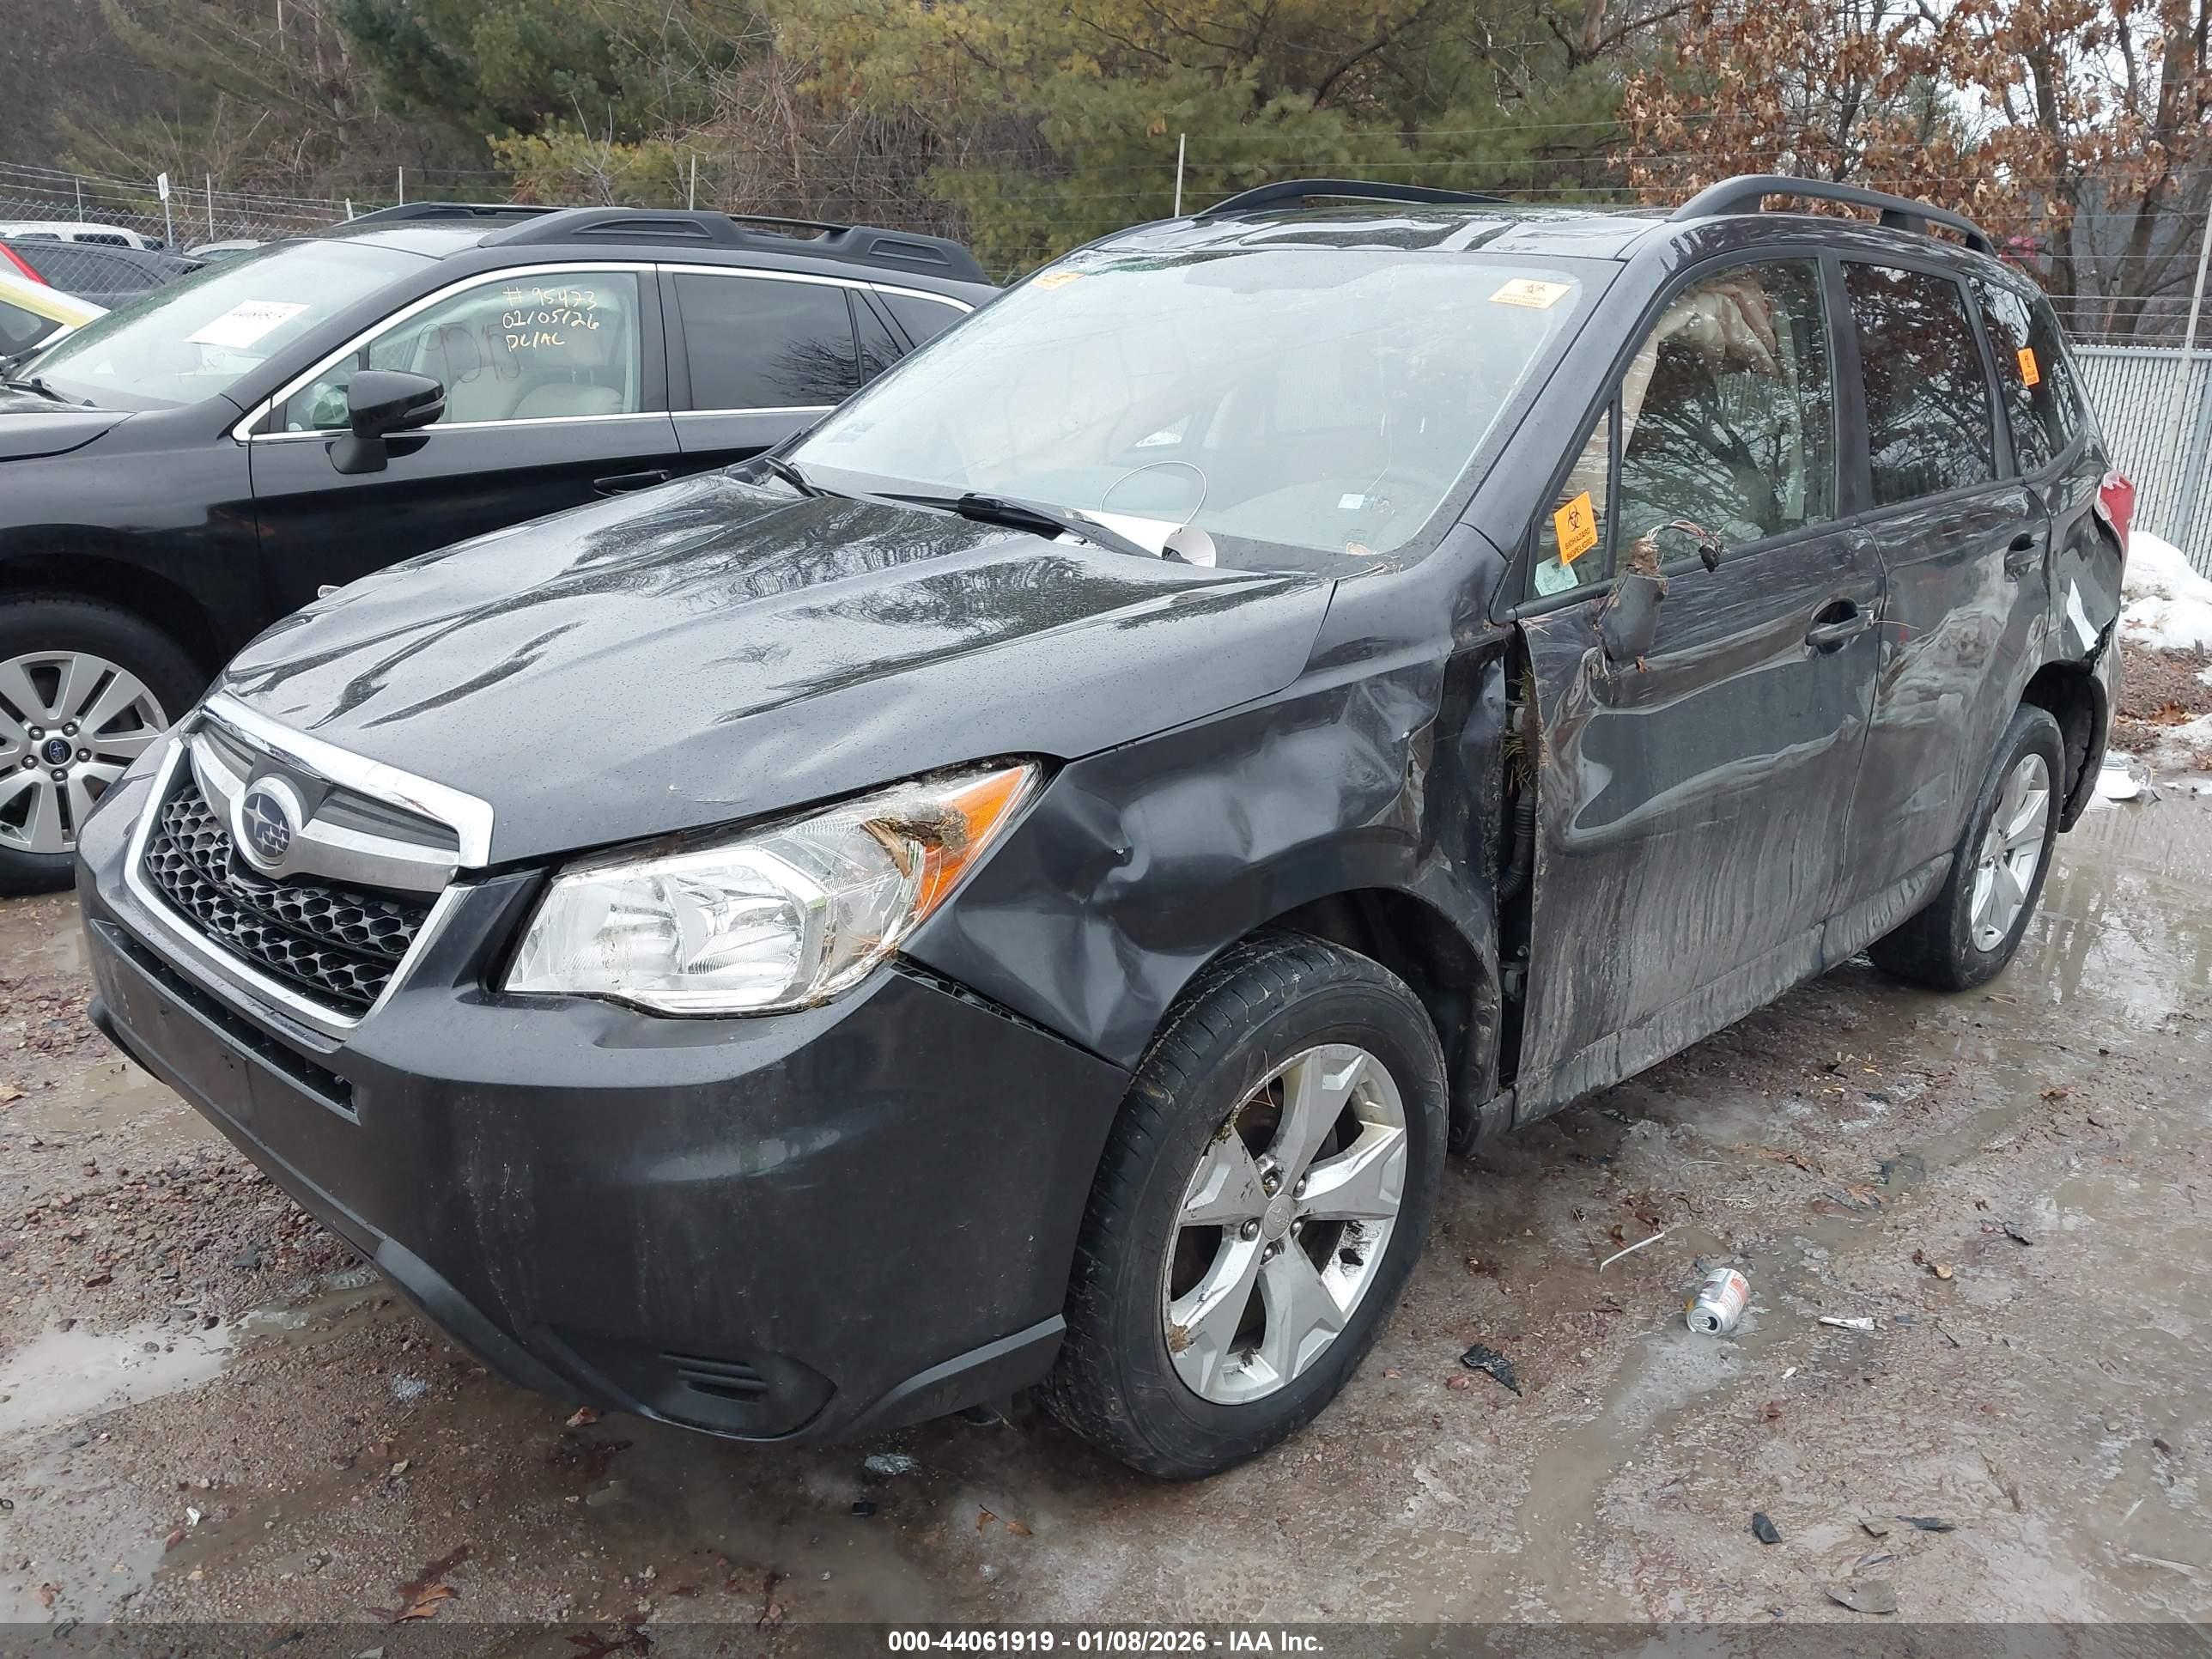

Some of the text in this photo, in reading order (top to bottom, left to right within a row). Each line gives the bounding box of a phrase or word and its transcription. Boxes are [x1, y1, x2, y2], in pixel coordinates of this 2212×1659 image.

[502, 286, 597, 311] # 95473
[1565, 527, 1591, 549] BIOHAZARD
[1566, 537, 1593, 560] BIOPELIGRO
